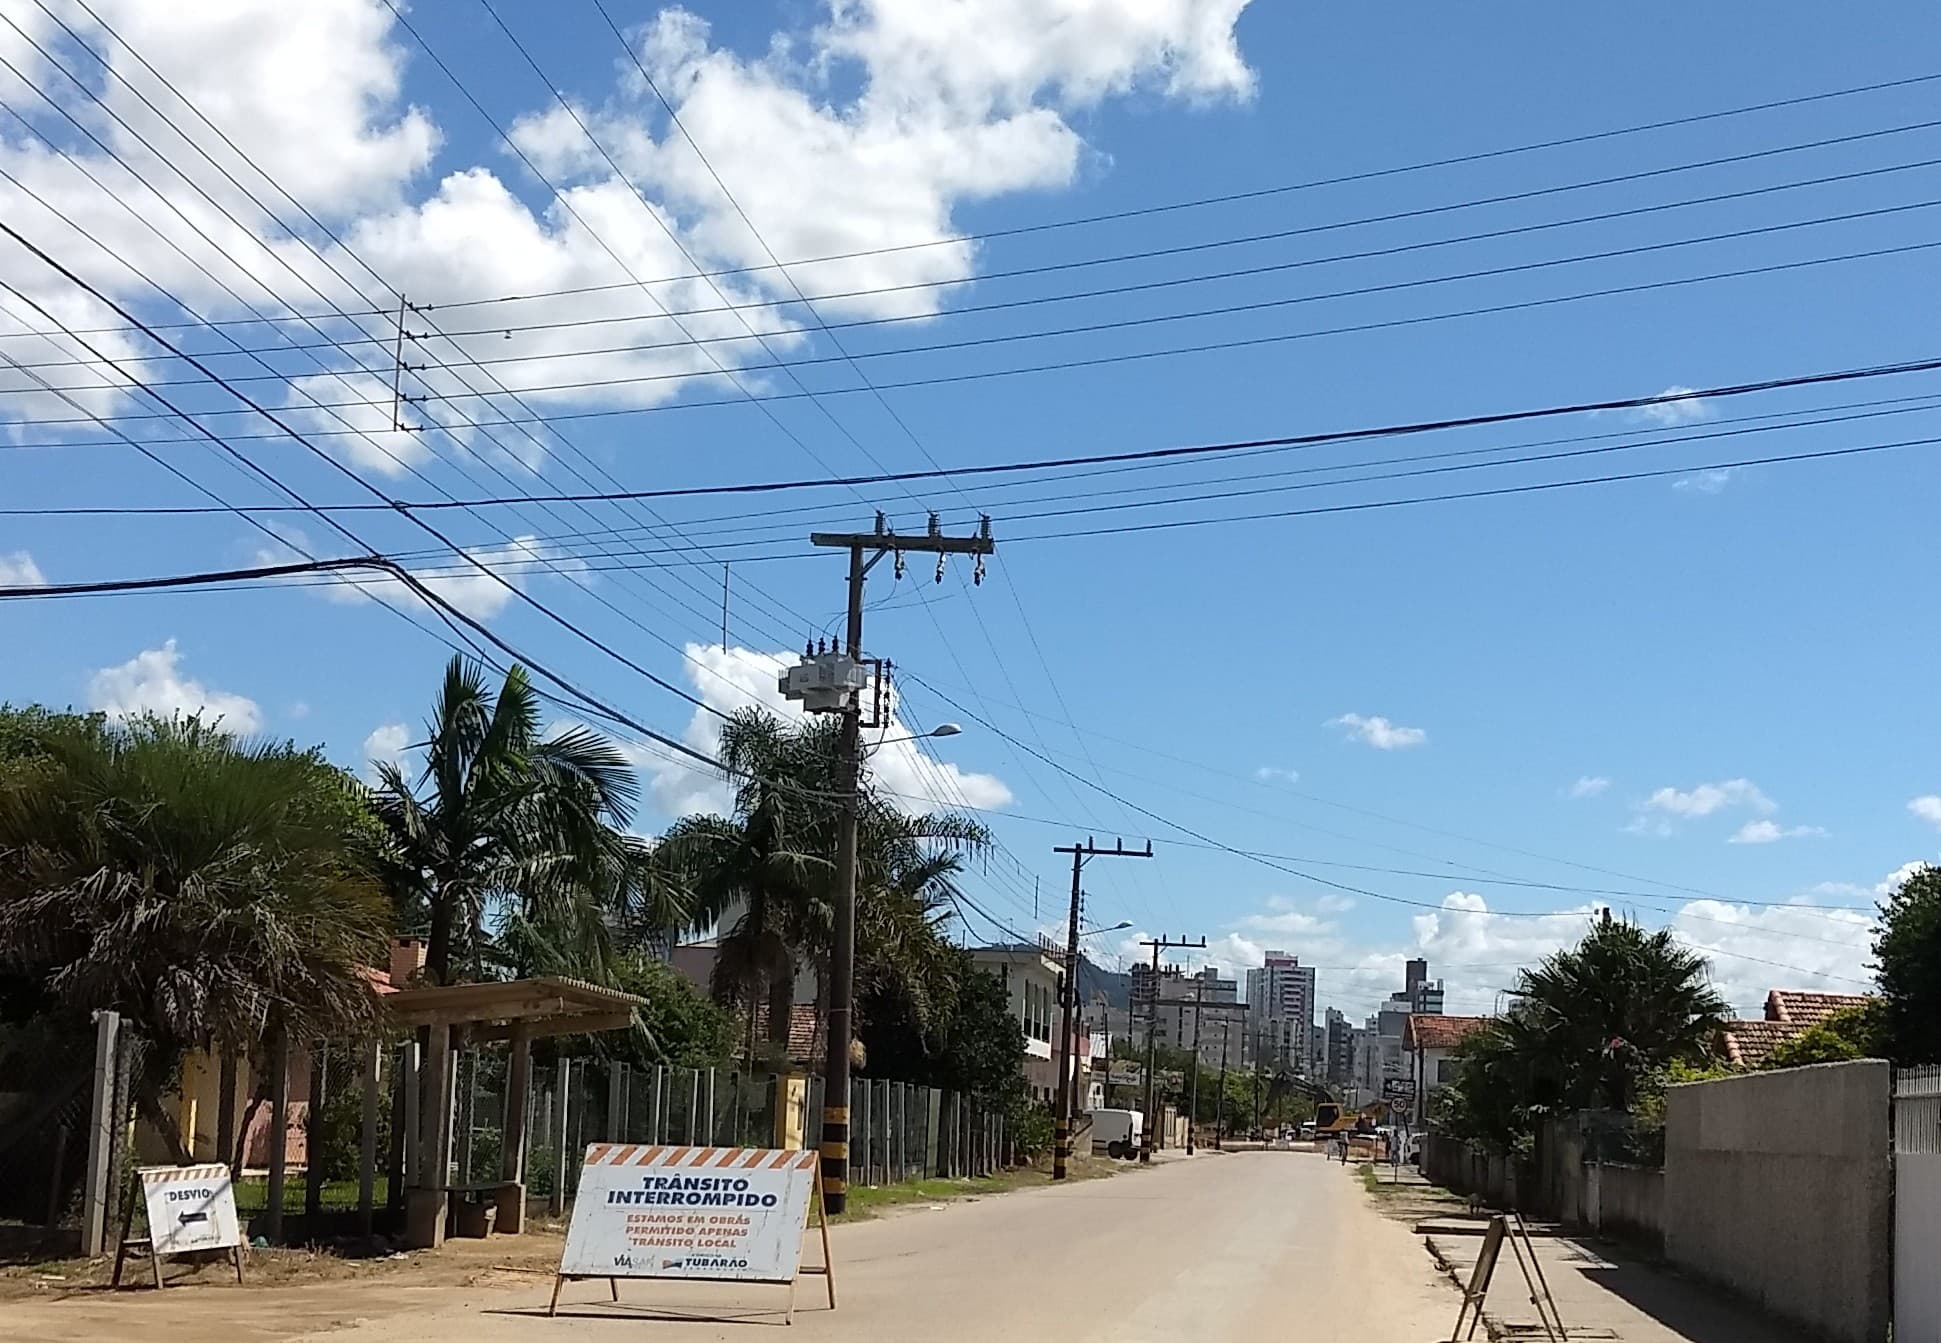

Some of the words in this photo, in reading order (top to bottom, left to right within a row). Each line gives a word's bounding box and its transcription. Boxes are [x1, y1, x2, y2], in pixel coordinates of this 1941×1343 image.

[642, 1173, 749, 1192] TRÂNSITO
[170, 1189, 209, 1201] DESVIO
[607, 1190, 778, 1207] INTERROMPIDO
[627, 1214, 684, 1224] ESTAMOS
[687, 1215, 705, 1224] EM
[625, 1225, 695, 1235] PERMITIDO
[698, 1227, 748, 1237] APENAS
[697, 1238, 737, 1248] LOCAL
